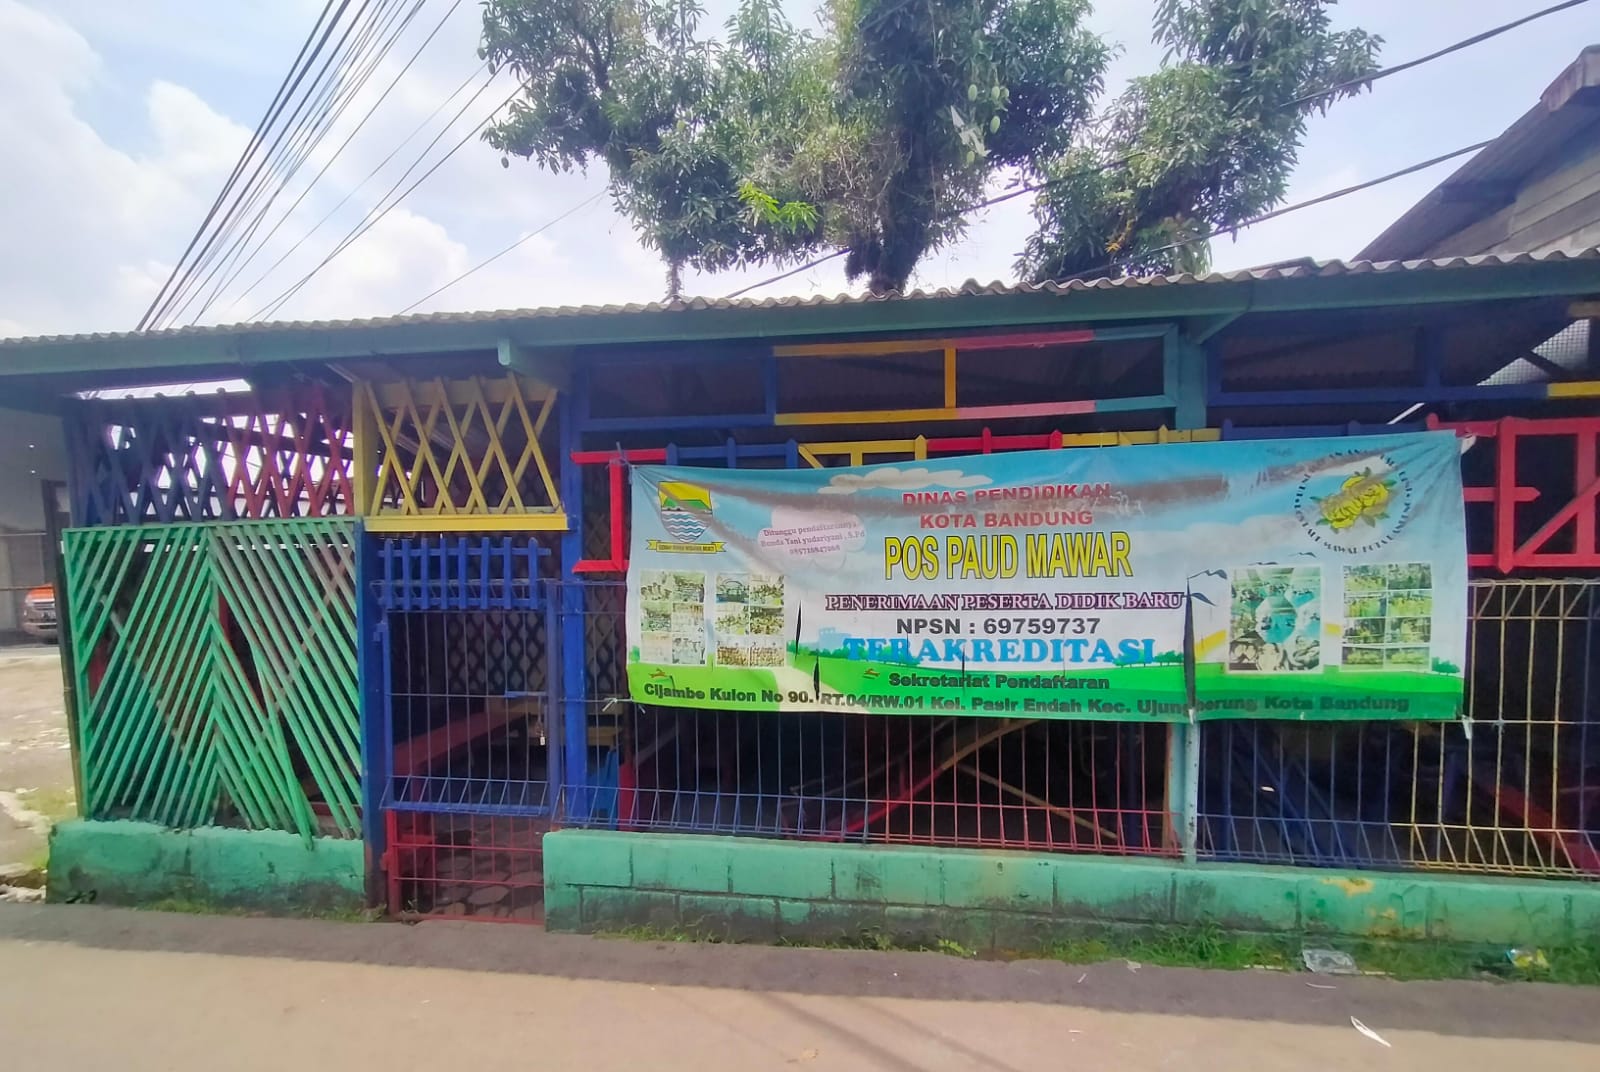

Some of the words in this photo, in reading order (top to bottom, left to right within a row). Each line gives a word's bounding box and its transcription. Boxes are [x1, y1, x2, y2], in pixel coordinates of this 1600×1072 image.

[903, 491, 967, 506] DINAS
[974, 483, 1111, 501] PENDIDIKAN
[920, 514, 977, 529] KOTA
[984, 511, 1093, 528] BANDUNG
[884, 535, 940, 580] POS
[947, 534, 1019, 580] PAUD
[1025, 531, 1134, 578] MAWAR
[825, 594, 960, 611] PENERIMAAN
[961, 593, 1051, 611] PESERTA
[1054, 592, 1118, 610] DIDIK
[1123, 592, 1185, 610] BARU
[896, 618, 962, 634] NPSN
[983, 617, 1101, 634] 69759737
[843, 637, 1157, 664] TERAKREDITASI
[889, 673, 990, 688] Sekretariat
[995, 674, 1110, 689] Pendaftaran
[644, 684, 705, 700] Cijambe
[710, 688, 757, 702] Kulon
[762, 690, 784, 703] No
[931, 696, 966, 710] Kel.
[971, 697, 1019, 712] Pasir
[1024, 698, 1082, 713] Endah
[1088, 699, 1132, 713] Kec.
[1265, 695, 1313, 710] Kota
[1320, 696, 1409, 712] Bandung
